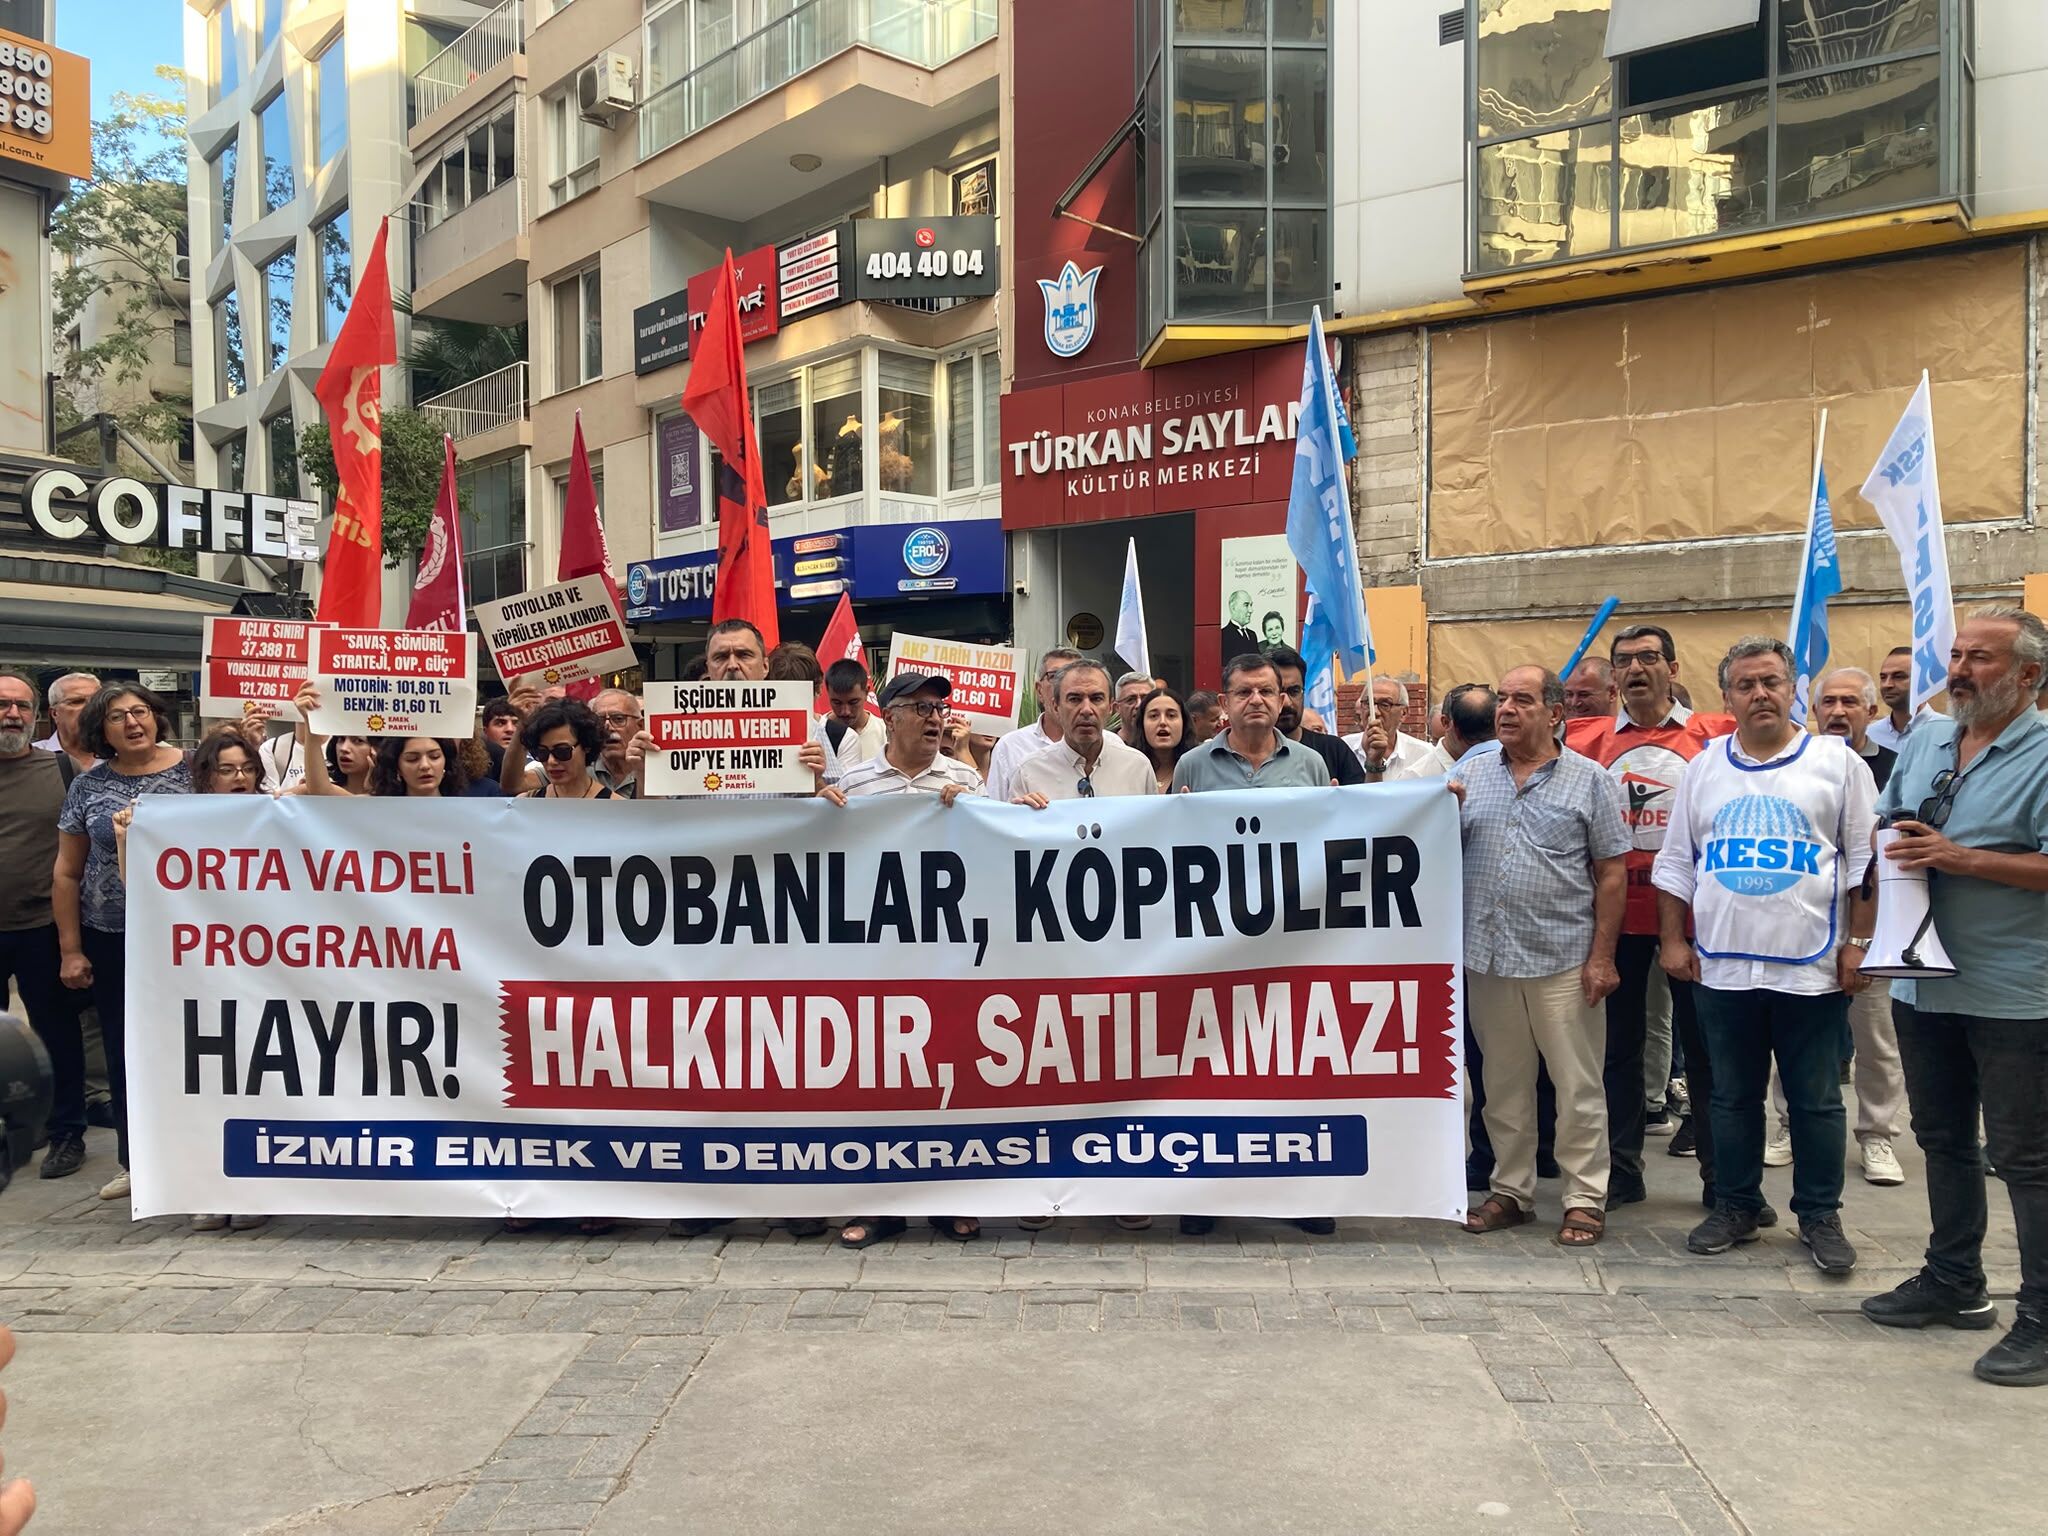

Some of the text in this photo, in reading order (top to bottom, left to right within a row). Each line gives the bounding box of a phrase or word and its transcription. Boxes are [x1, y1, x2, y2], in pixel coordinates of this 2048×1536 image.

[0, 42, 52, 78] 850
[866, 249, 984, 279] 404 40 04
[1087, 384, 1239, 424] KONAK BELEDİYESİ
[1008, 424, 1152, 476] TÜRKAN
[1067, 452, 1261, 497] KÜLTÜR MERKEZİ
[25, 469, 320, 562] COFFEE
[912, 545, 940, 557] EROL
[502, 586, 583, 621] OTOYOLLAR VE
[239, 621, 305, 641] AÇLIK SINIRI
[492, 604, 611, 649] KÖPRÜLER HALKINDIR
[241, 641, 297, 658] 37,388 TL
[342, 633, 449, 654] "SAVAŞ, SÖMÜRÜ,
[501, 628, 612, 671] ÖZELLEŞTİRİLEMEZ!
[902, 640, 1014, 670] AKP TARİH YAZDI
[227, 662, 308, 679] YOKSULLUK SINIR
[332, 653, 456, 676] STRATEJİ, OVP, GÜÇ"
[560, 663, 579, 673] EMEK
[563, 667, 590, 680] PARTİSİ
[239, 681, 289, 697] 121,786 TL
[334, 676, 451, 696] MOTORİN: 101,80 TL
[958, 670, 997, 688] 101,80
[1000, 675, 1012, 691] TL
[343, 695, 442, 714] BENZİN: 81,60 TL
[673, 685, 776, 715] İŞÇİDEN ALIP
[952, 689, 1002, 709] 81,60 TL
[388, 723, 418, 731] PARTİSİ
[661, 718, 791, 741] PATRONA VEREN
[670, 749, 783, 771] OVP'YE HAYIR!
[725, 781, 755, 789] PARTİSİ
[156, 841, 474, 895] ORTA VADELİ
[1705, 838, 1823, 876] KESK
[523, 816, 1422, 967] OTOBANLAR, KÖPRÜLER
[1736, 876, 1774, 891] 1995
[172, 923, 462, 971] PROGRAMA
[183, 999, 461, 1100] HAYIR!
[528, 980, 1420, 1110] HALKINDIR, SATILAMAZ!
[255, 1124, 1333, 1172] İZMİR EMEK VE DEMOKRASİ GÜÇLERİ
